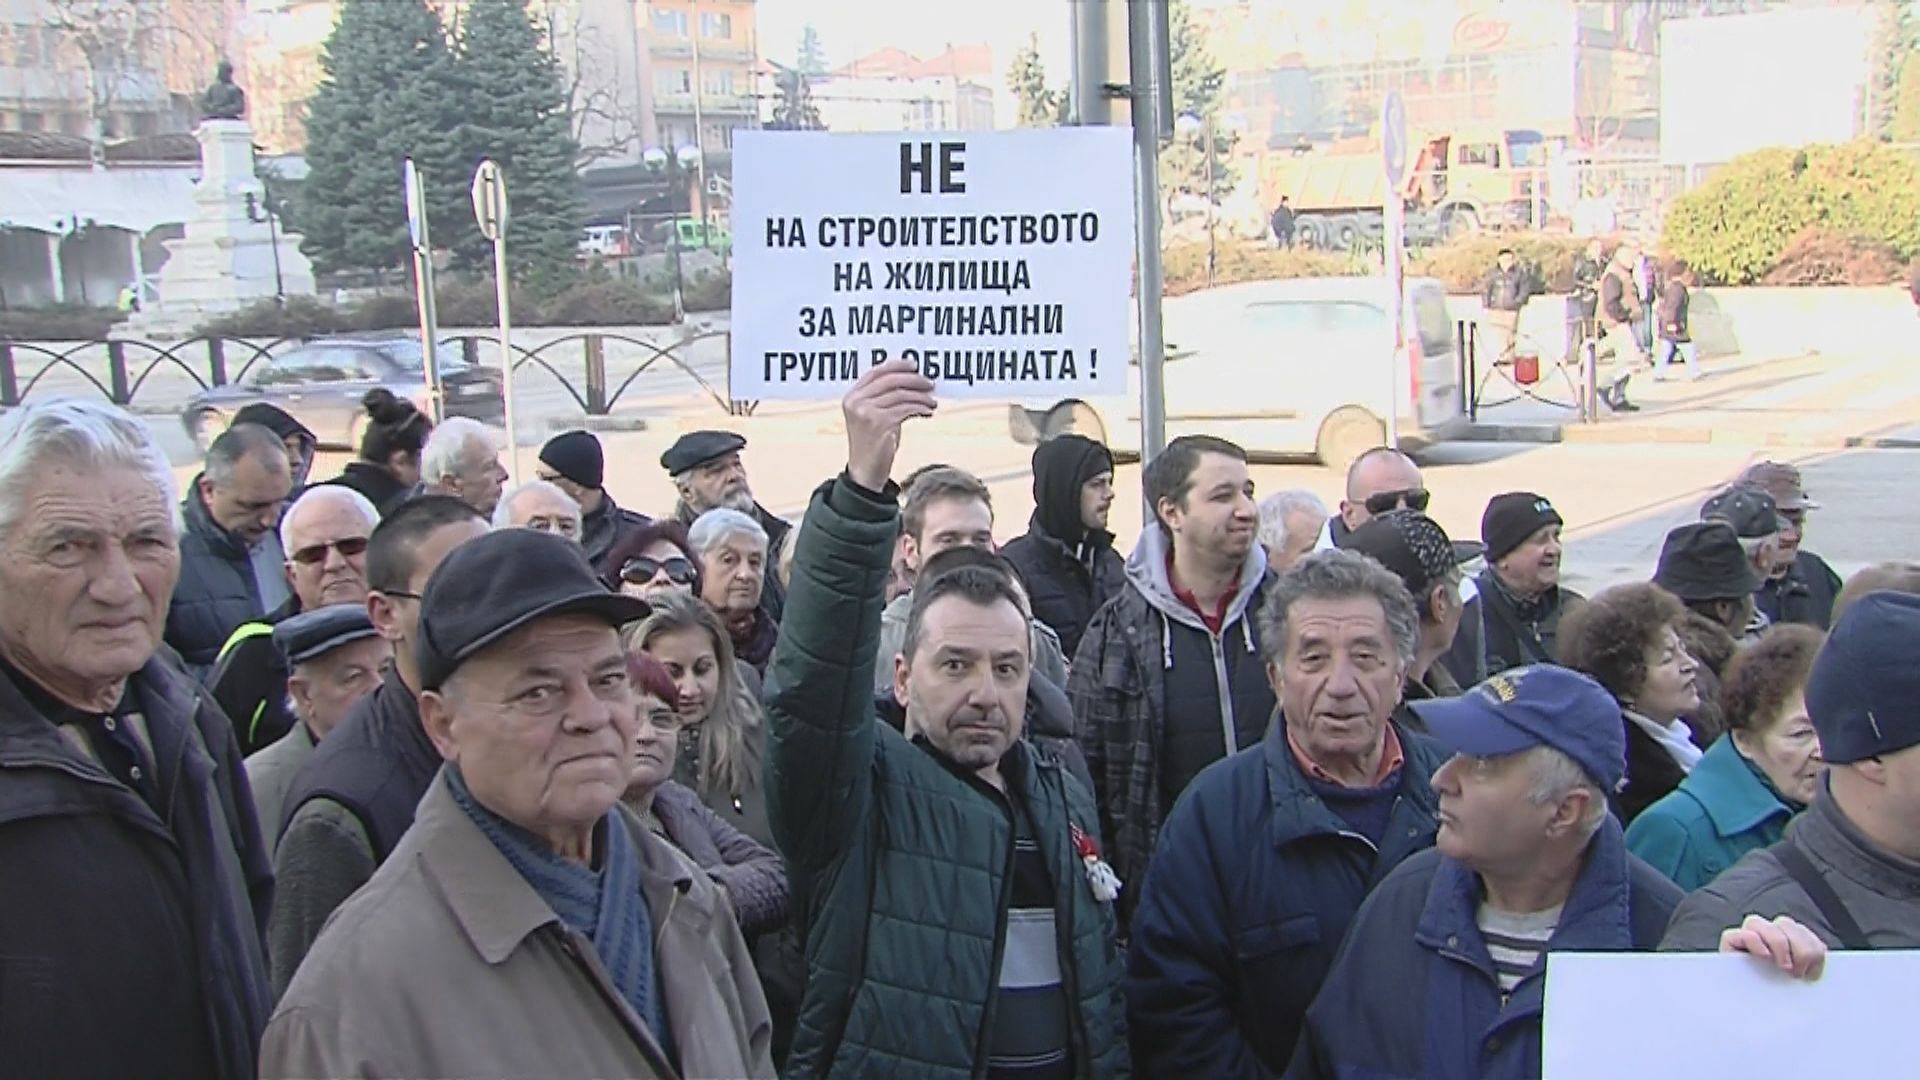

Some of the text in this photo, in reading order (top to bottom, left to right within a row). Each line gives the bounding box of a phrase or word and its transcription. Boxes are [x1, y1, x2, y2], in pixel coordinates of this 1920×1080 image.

[900, 142, 966, 193] НЕ
[767, 212, 1099, 247] НА СТРОИТЕЛСТВОТО
[834, 260, 1031, 295] НА ЖИЛИЩА
[799, 304, 1064, 338] ЗА МАРГИНАЛНИ
[764, 352, 859, 381] ГРУПИ
